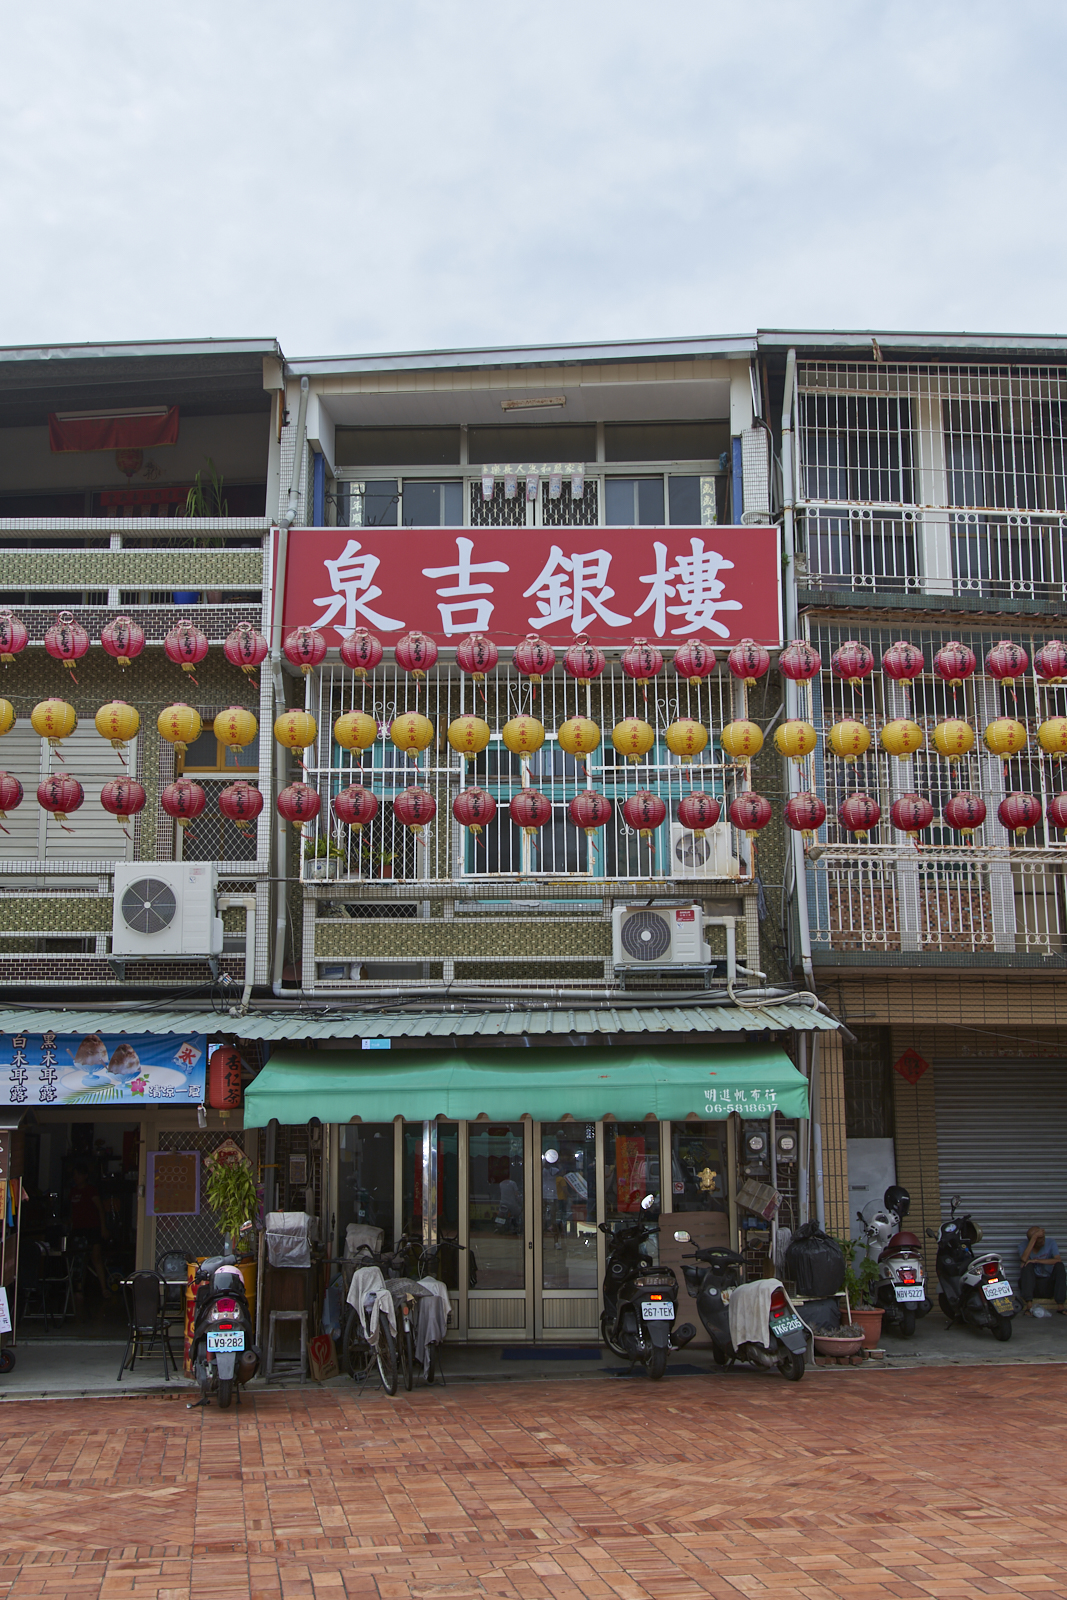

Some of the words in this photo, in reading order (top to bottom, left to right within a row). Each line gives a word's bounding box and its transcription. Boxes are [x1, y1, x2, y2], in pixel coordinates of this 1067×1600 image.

[311, 536, 744, 638] 泉吉銀樓
[9, 1034, 29, 1103] 白木耳露
[39, 1033, 58, 1103] 黑木耳露
[224, 1054, 240, 1104] 杏仁茶
[149, 1084, 201, 1098] 清涼一夏
[704, 1088, 777, 1102] 明進帆布行
[705, 1103, 778, 1113] 06-5818617
[208, 1337, 243, 1348] LV9-282
